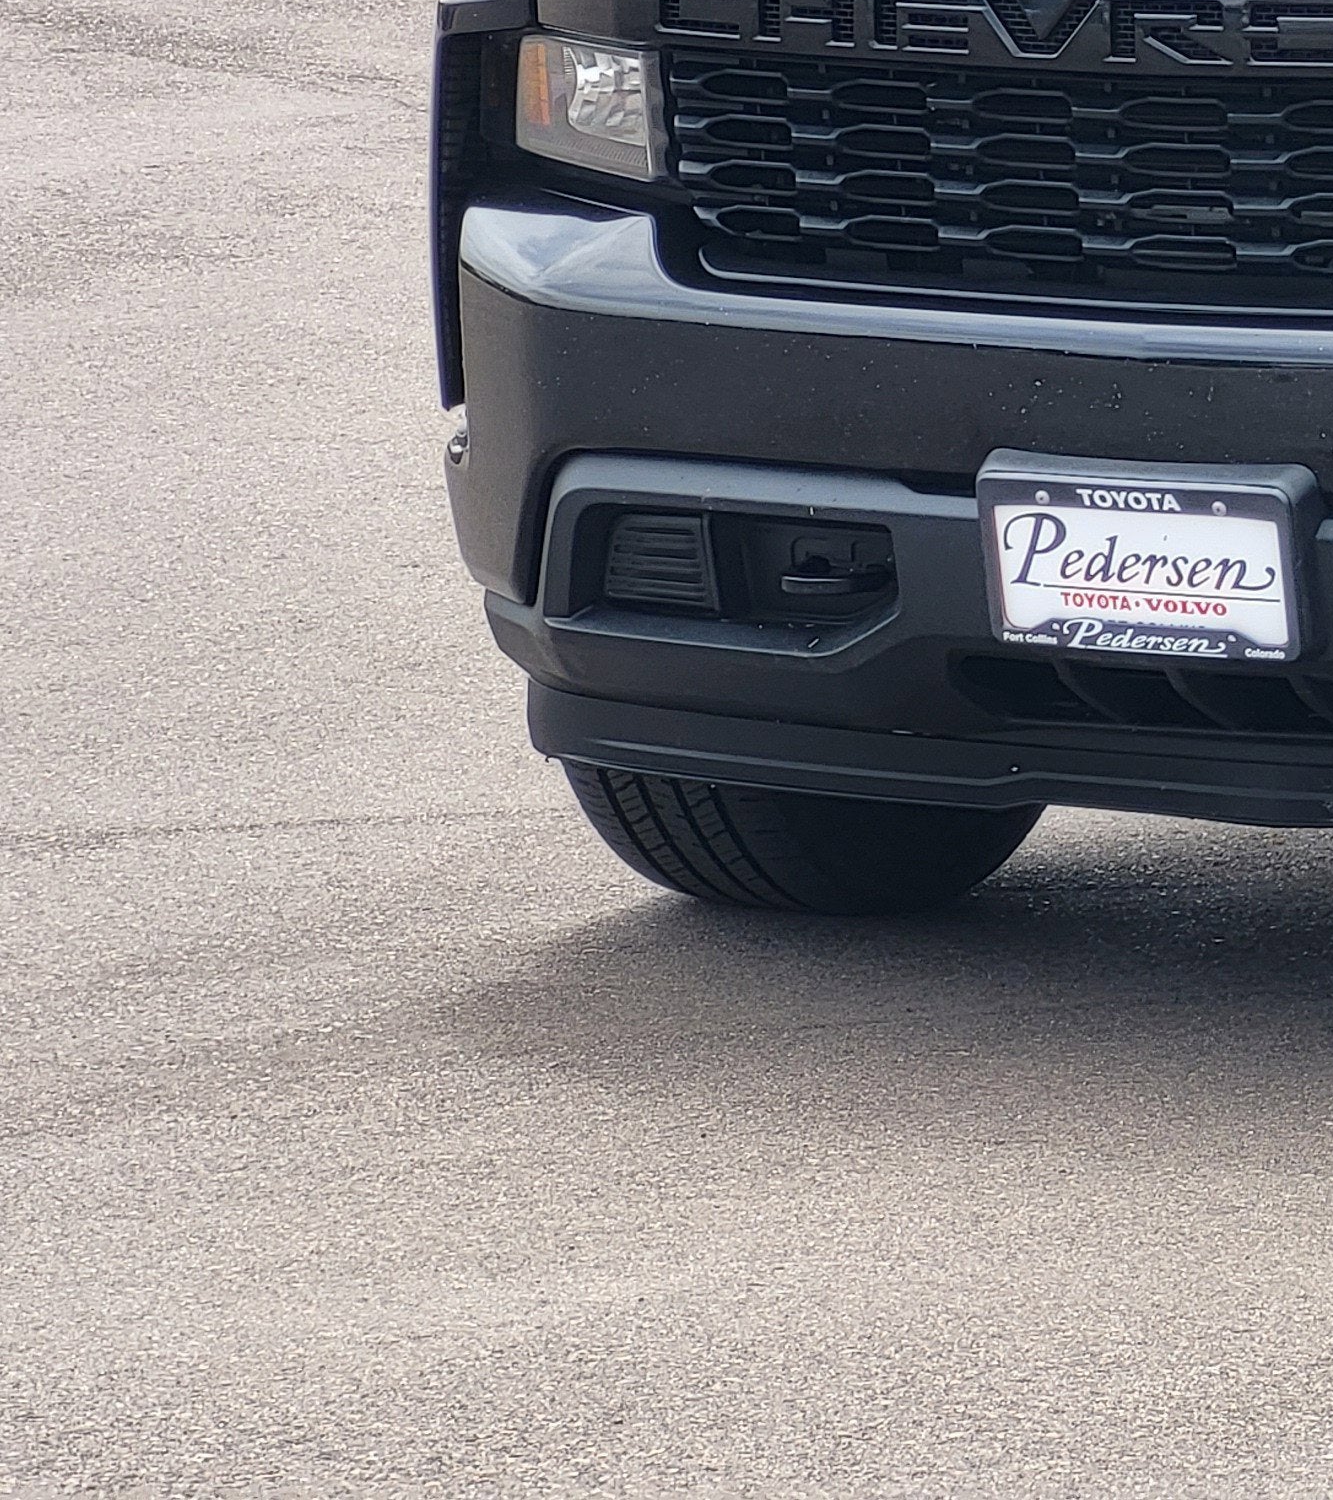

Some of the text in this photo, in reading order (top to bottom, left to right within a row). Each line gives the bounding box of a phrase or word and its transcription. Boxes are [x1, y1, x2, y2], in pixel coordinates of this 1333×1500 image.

[1075, 487, 1182, 513] TOYOTA
[1003, 512, 1277, 592] Pedersen
[1060, 591, 1228, 618] TOYOTA VOLVO
[1002, 630, 1059, 645] Fort Collins
[1062, 617, 1227, 654] Pedersen
[1244, 647, 1287, 661] Colorado
